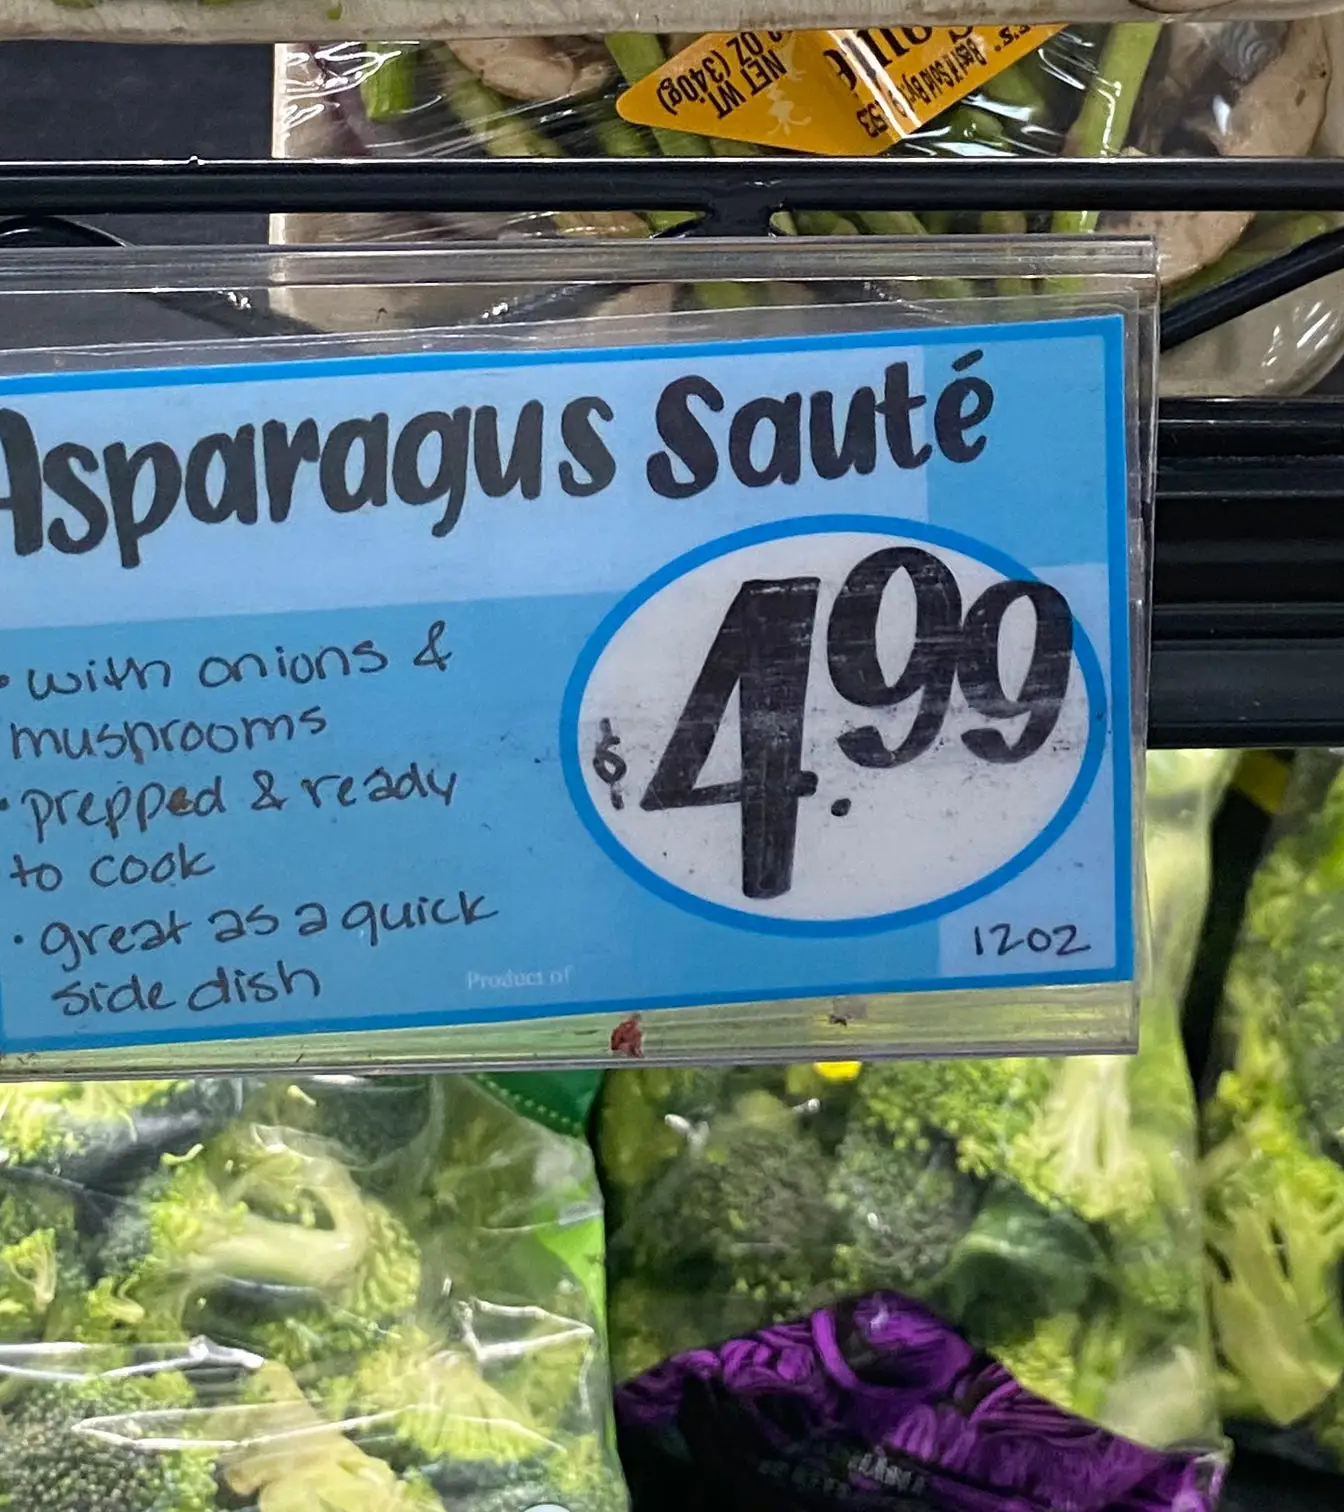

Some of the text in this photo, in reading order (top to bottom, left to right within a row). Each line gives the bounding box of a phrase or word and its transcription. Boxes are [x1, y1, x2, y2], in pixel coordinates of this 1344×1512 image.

[657, 50, 731, 116] (340g)
[750, 47, 788, 97] NET
[645, 347, 994, 500] Sauté
[27, 619, 455, 701] with onions &
[9, 705, 328, 766] mushrooms
[21, 761, 458, 843] prepped & ready
[9, 842, 217, 892] to cook
[40, 890, 500, 973] great as a quick
[50, 959, 322, 1018] side dish
[465, 965, 543, 990] Product
